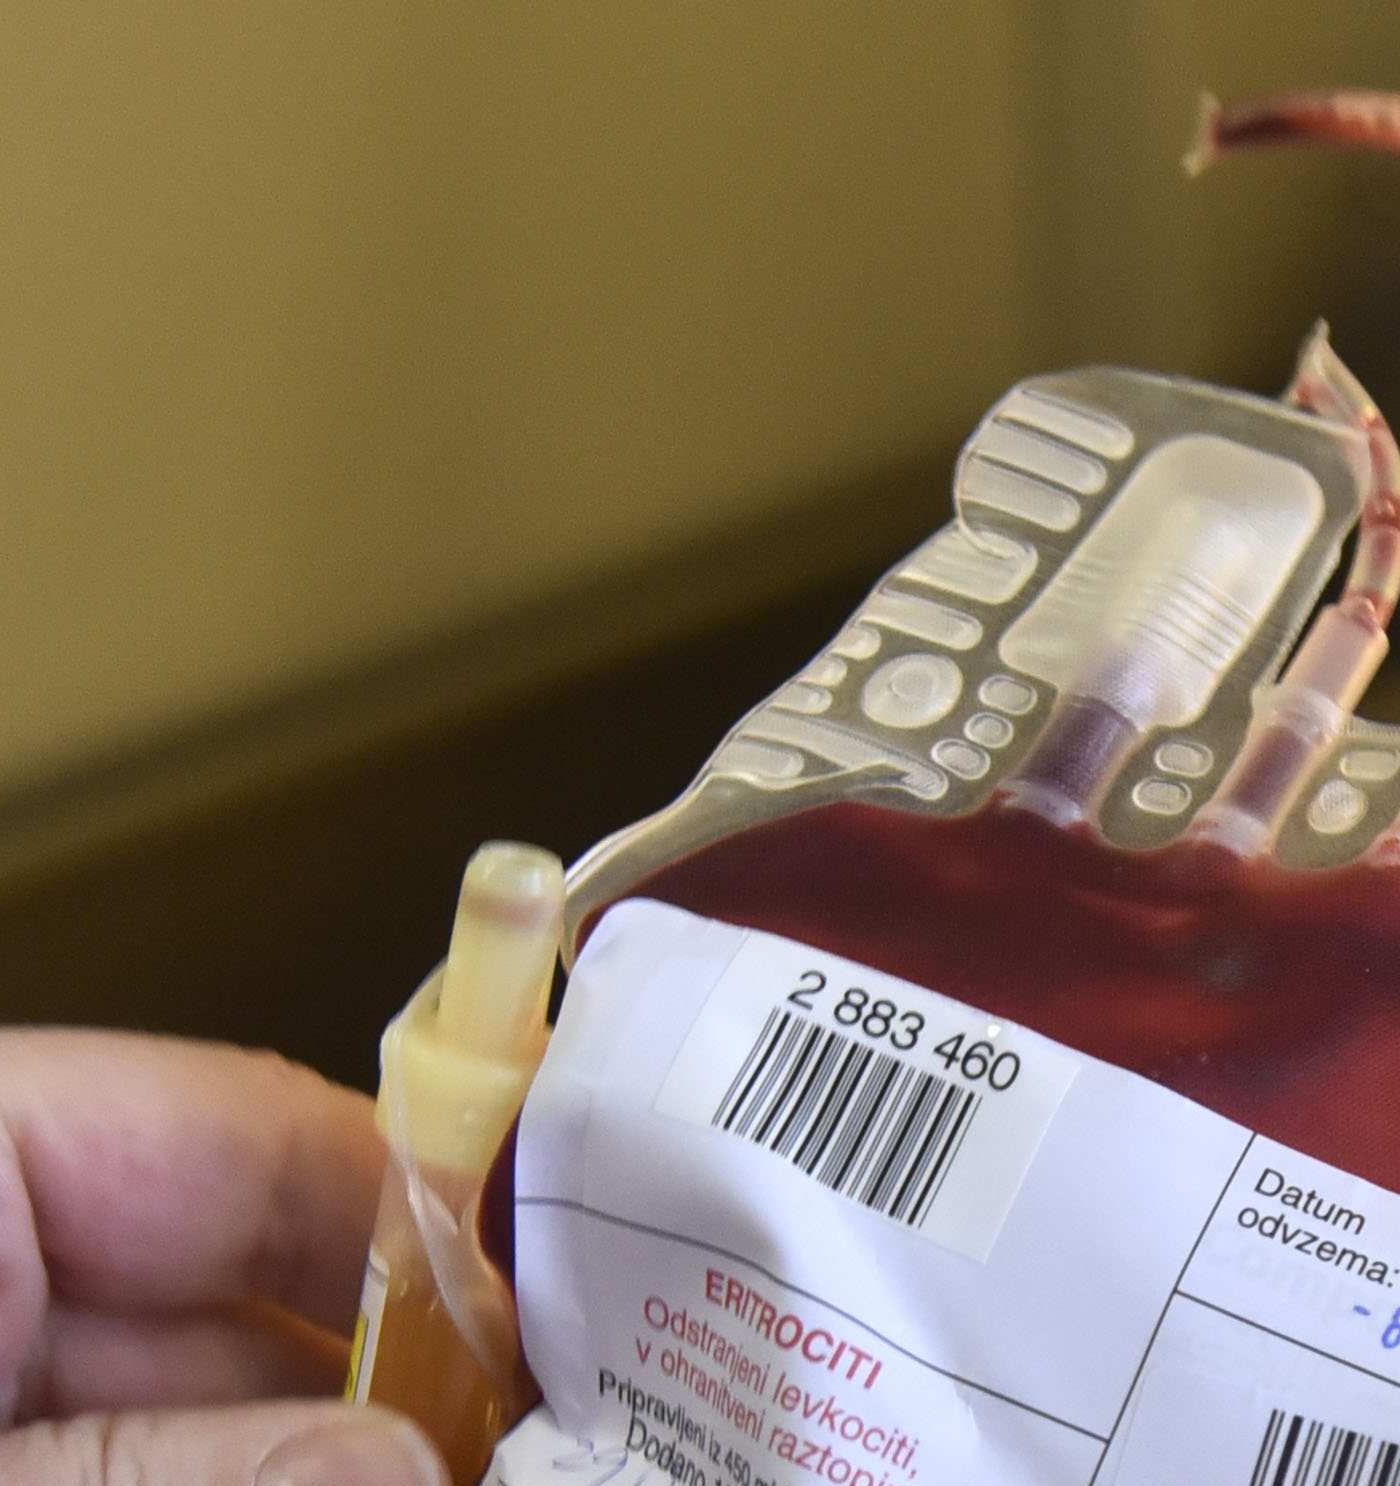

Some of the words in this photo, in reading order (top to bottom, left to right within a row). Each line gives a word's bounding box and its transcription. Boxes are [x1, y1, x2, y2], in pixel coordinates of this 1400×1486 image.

[787, 970, 827, 1011] 2
[833, 987, 925, 1050] 883
[933, 1033, 1021, 1091] 460
[1236, 1206, 1400, 1289] odvzema:
[1253, 1166, 1367, 1236] Datum
[705, 1268, 883, 1390] ERITROCITI
[598, 1368, 708, 1453] Pripravljeni
[708, 1430, 722, 1467] iz
[636, 1338, 651, 1365] v
[660, 1346, 767, 1442] ohranitveni
[644, 1295, 771, 1395] Odstranjeni
[772, 1372, 919, 1480] levkociti,
